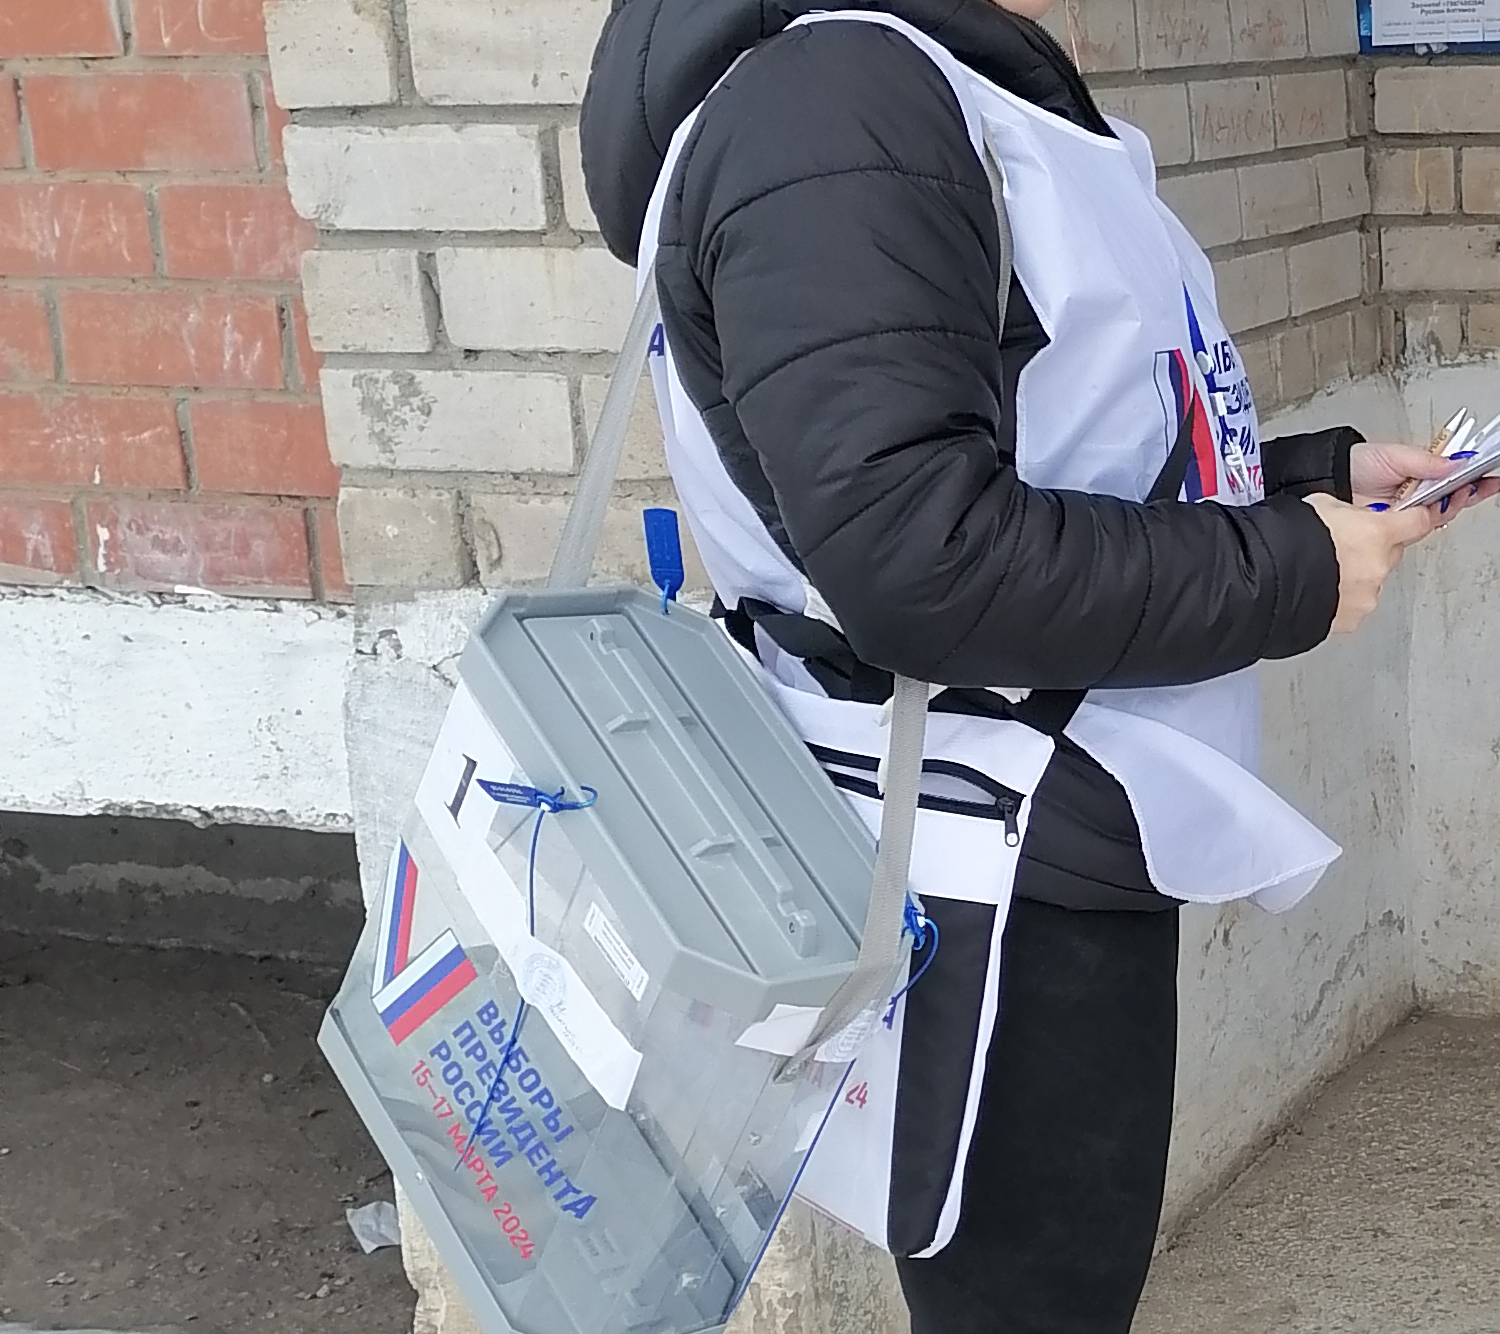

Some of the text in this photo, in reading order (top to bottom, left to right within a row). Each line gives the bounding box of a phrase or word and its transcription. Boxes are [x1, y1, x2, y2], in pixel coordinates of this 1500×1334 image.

[429, 1039, 515, 1169] РОССИИ
[476, 999, 575, 1144] ВЫБОРЫ
[446, 1122, 499, 1204] МАРТА
[493, 1201, 536, 1261] 2024
